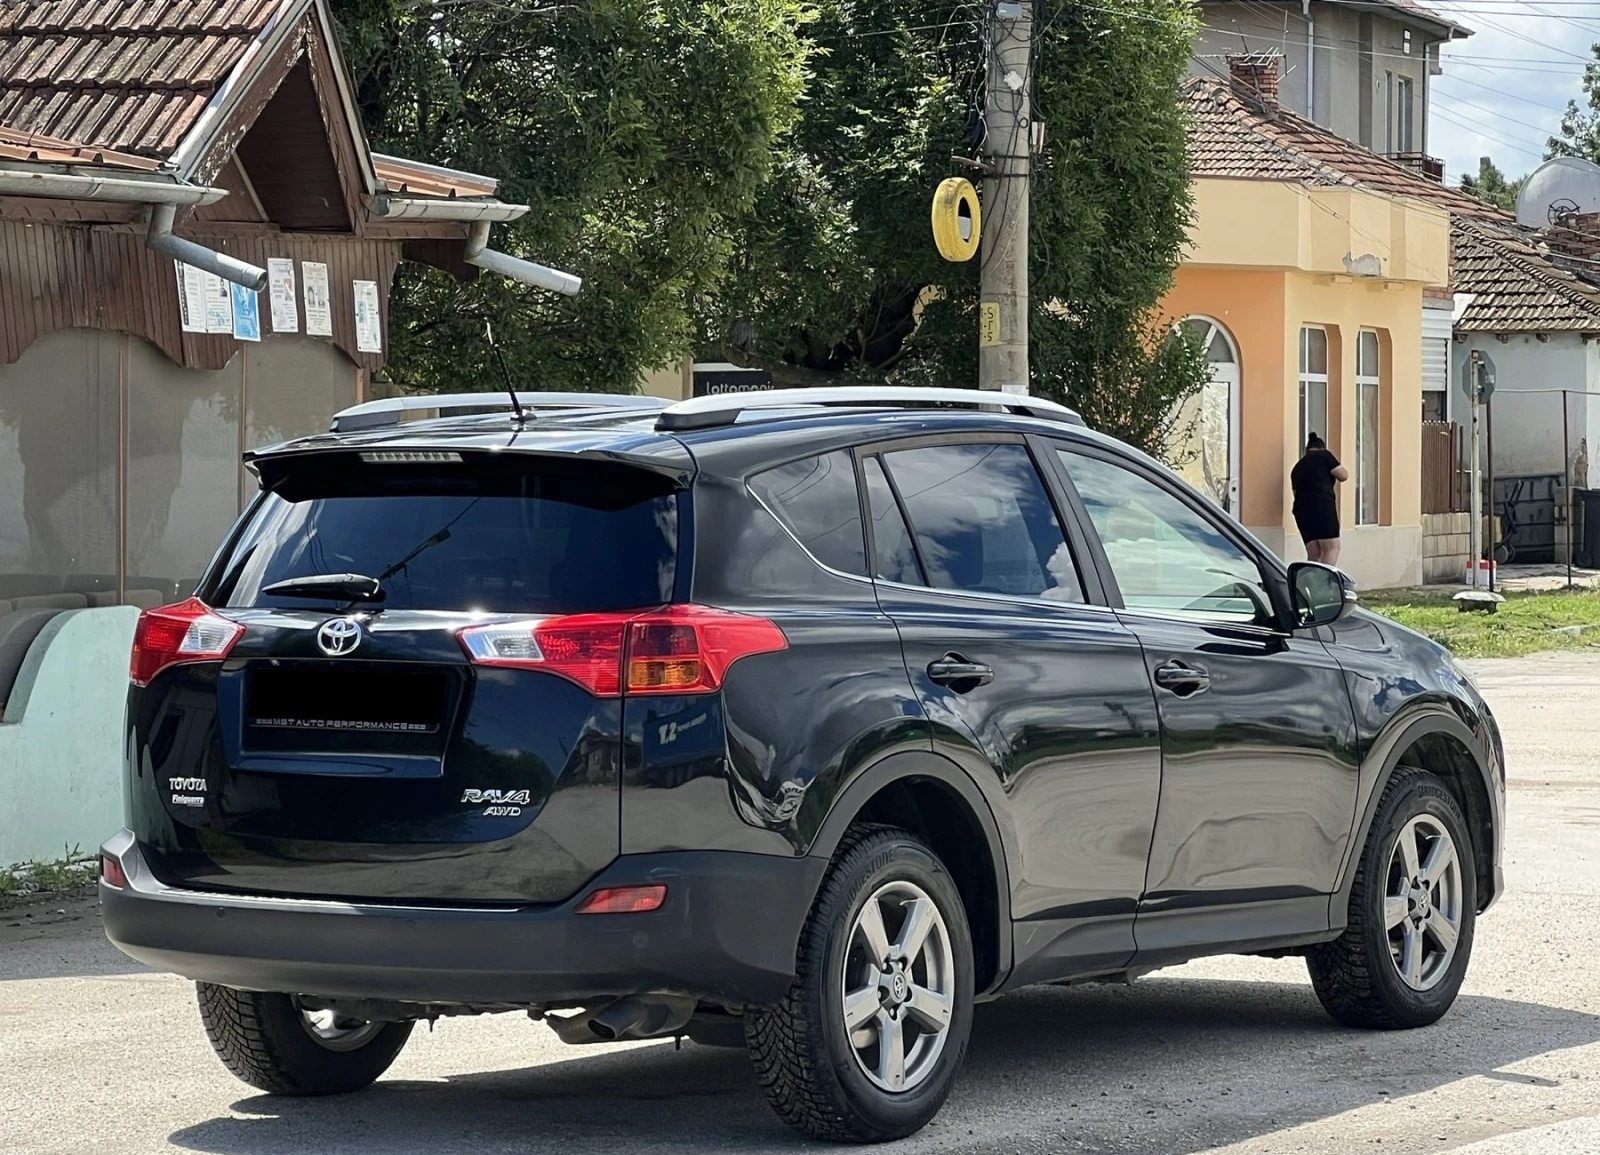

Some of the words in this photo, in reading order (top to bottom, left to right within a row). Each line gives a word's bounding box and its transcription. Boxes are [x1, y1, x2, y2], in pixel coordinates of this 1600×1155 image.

[296, 719, 325, 728] AUTO
[326, 720, 408, 731] PERFORMANCE
[169, 777, 207, 791] TOYOTA
[461, 788, 530, 804] RAV4
[483, 806, 521, 816] AWD
